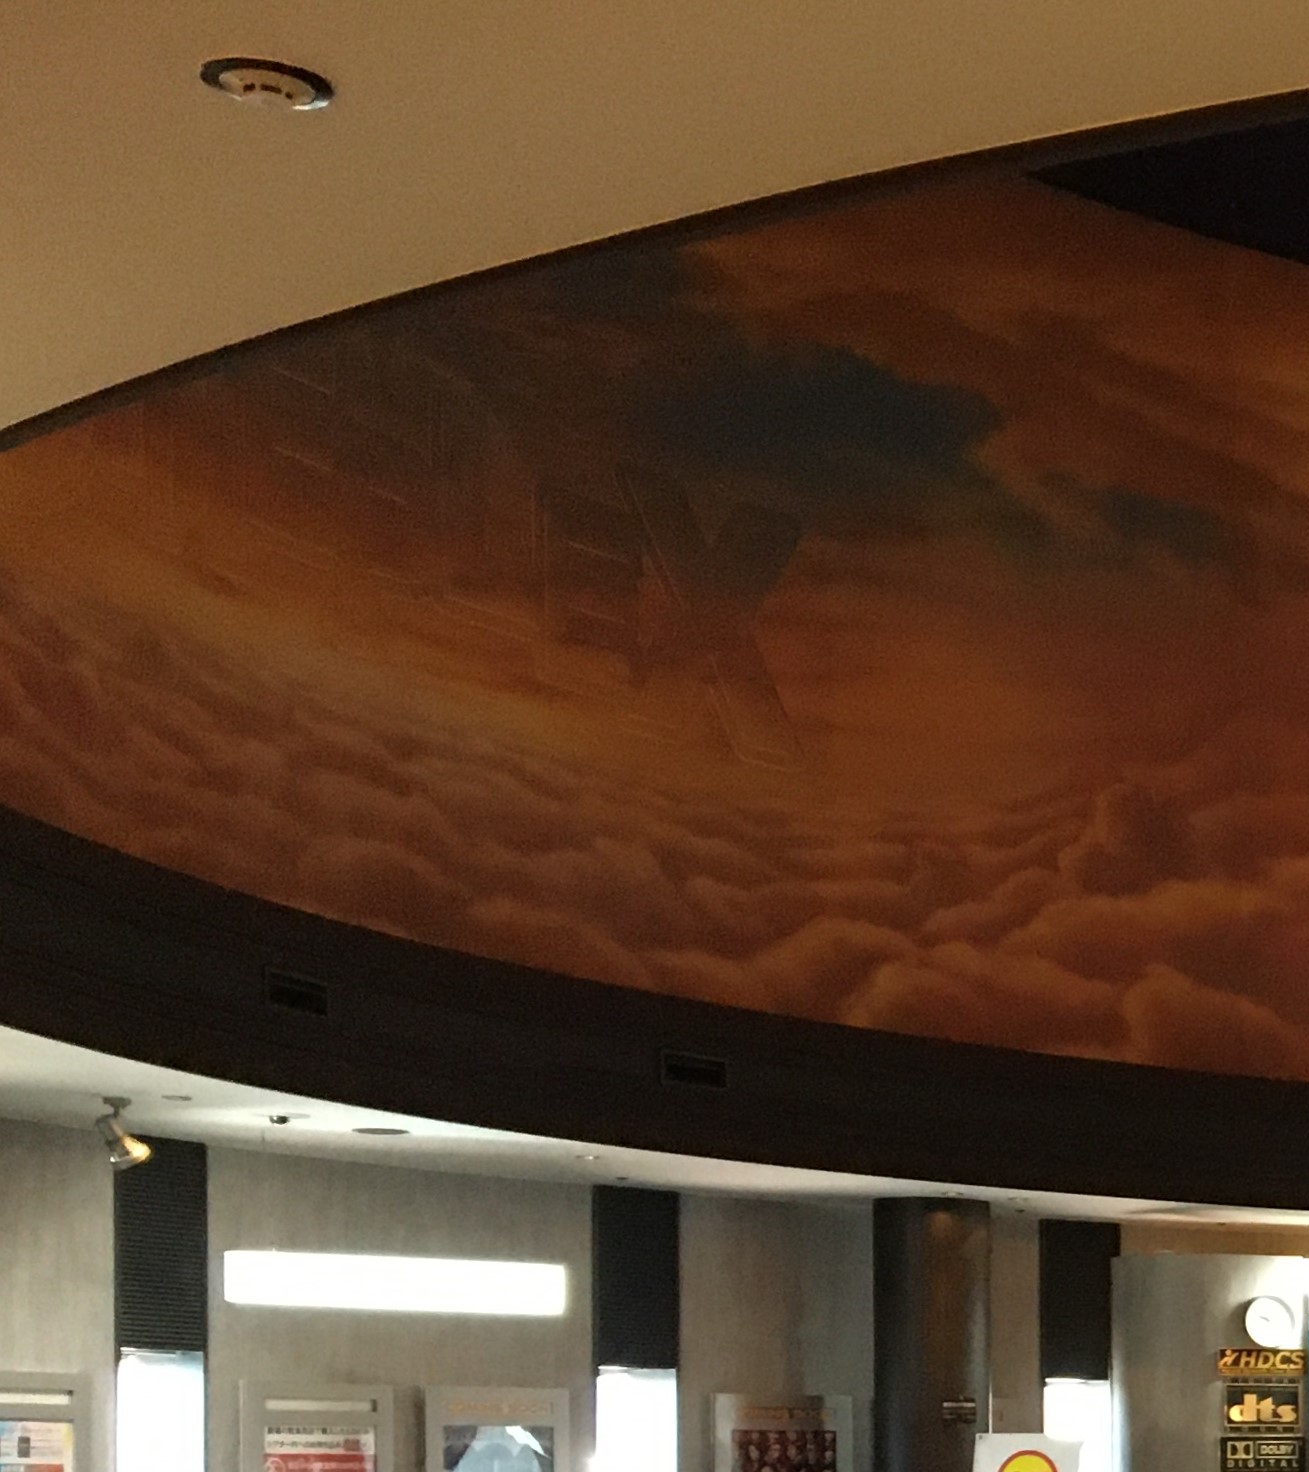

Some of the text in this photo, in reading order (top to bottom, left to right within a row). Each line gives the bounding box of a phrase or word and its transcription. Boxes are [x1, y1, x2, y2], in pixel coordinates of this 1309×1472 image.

[1240, 1351, 1305, 1370] HDCS
[1228, 1393, 1297, 1422] dts
[1260, 1445, 1294, 1455] DOLBY
[1227, 1459, 1299, 1468] DIGITAL
